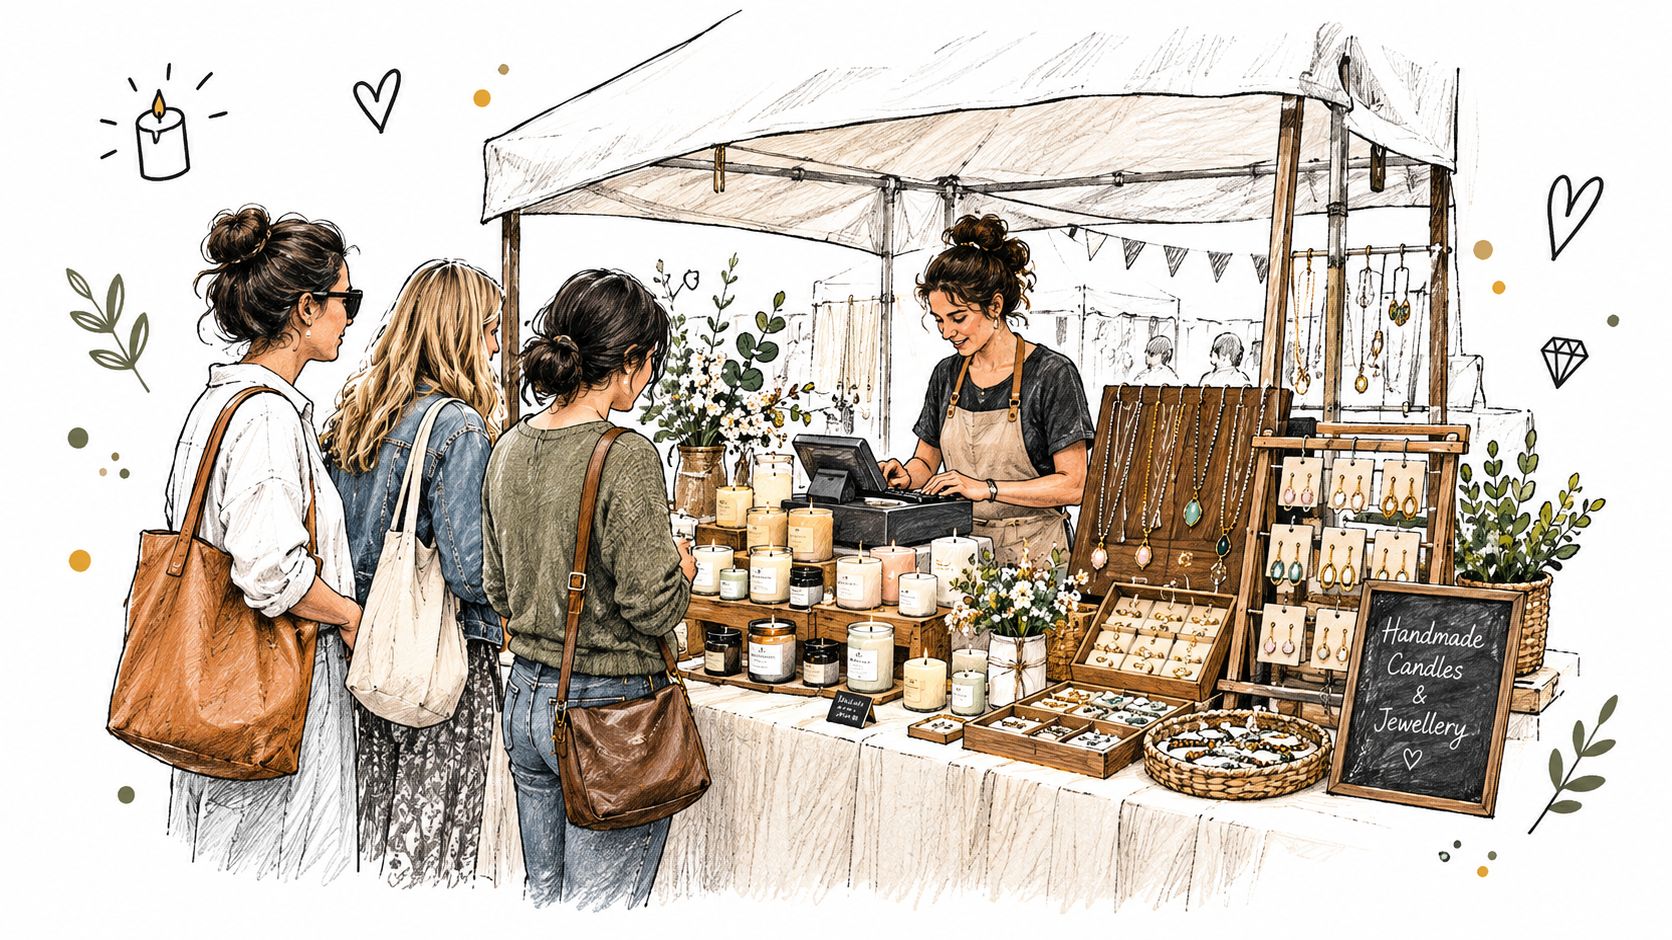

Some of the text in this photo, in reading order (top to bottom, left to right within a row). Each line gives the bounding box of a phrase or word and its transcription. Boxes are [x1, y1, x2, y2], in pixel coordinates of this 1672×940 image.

[1382, 616, 1485, 649] Handmade
[1387, 652, 1463, 680] Candles
[1412, 685, 1427, 704] &
[1373, 707, 1469, 751] Jewellery
